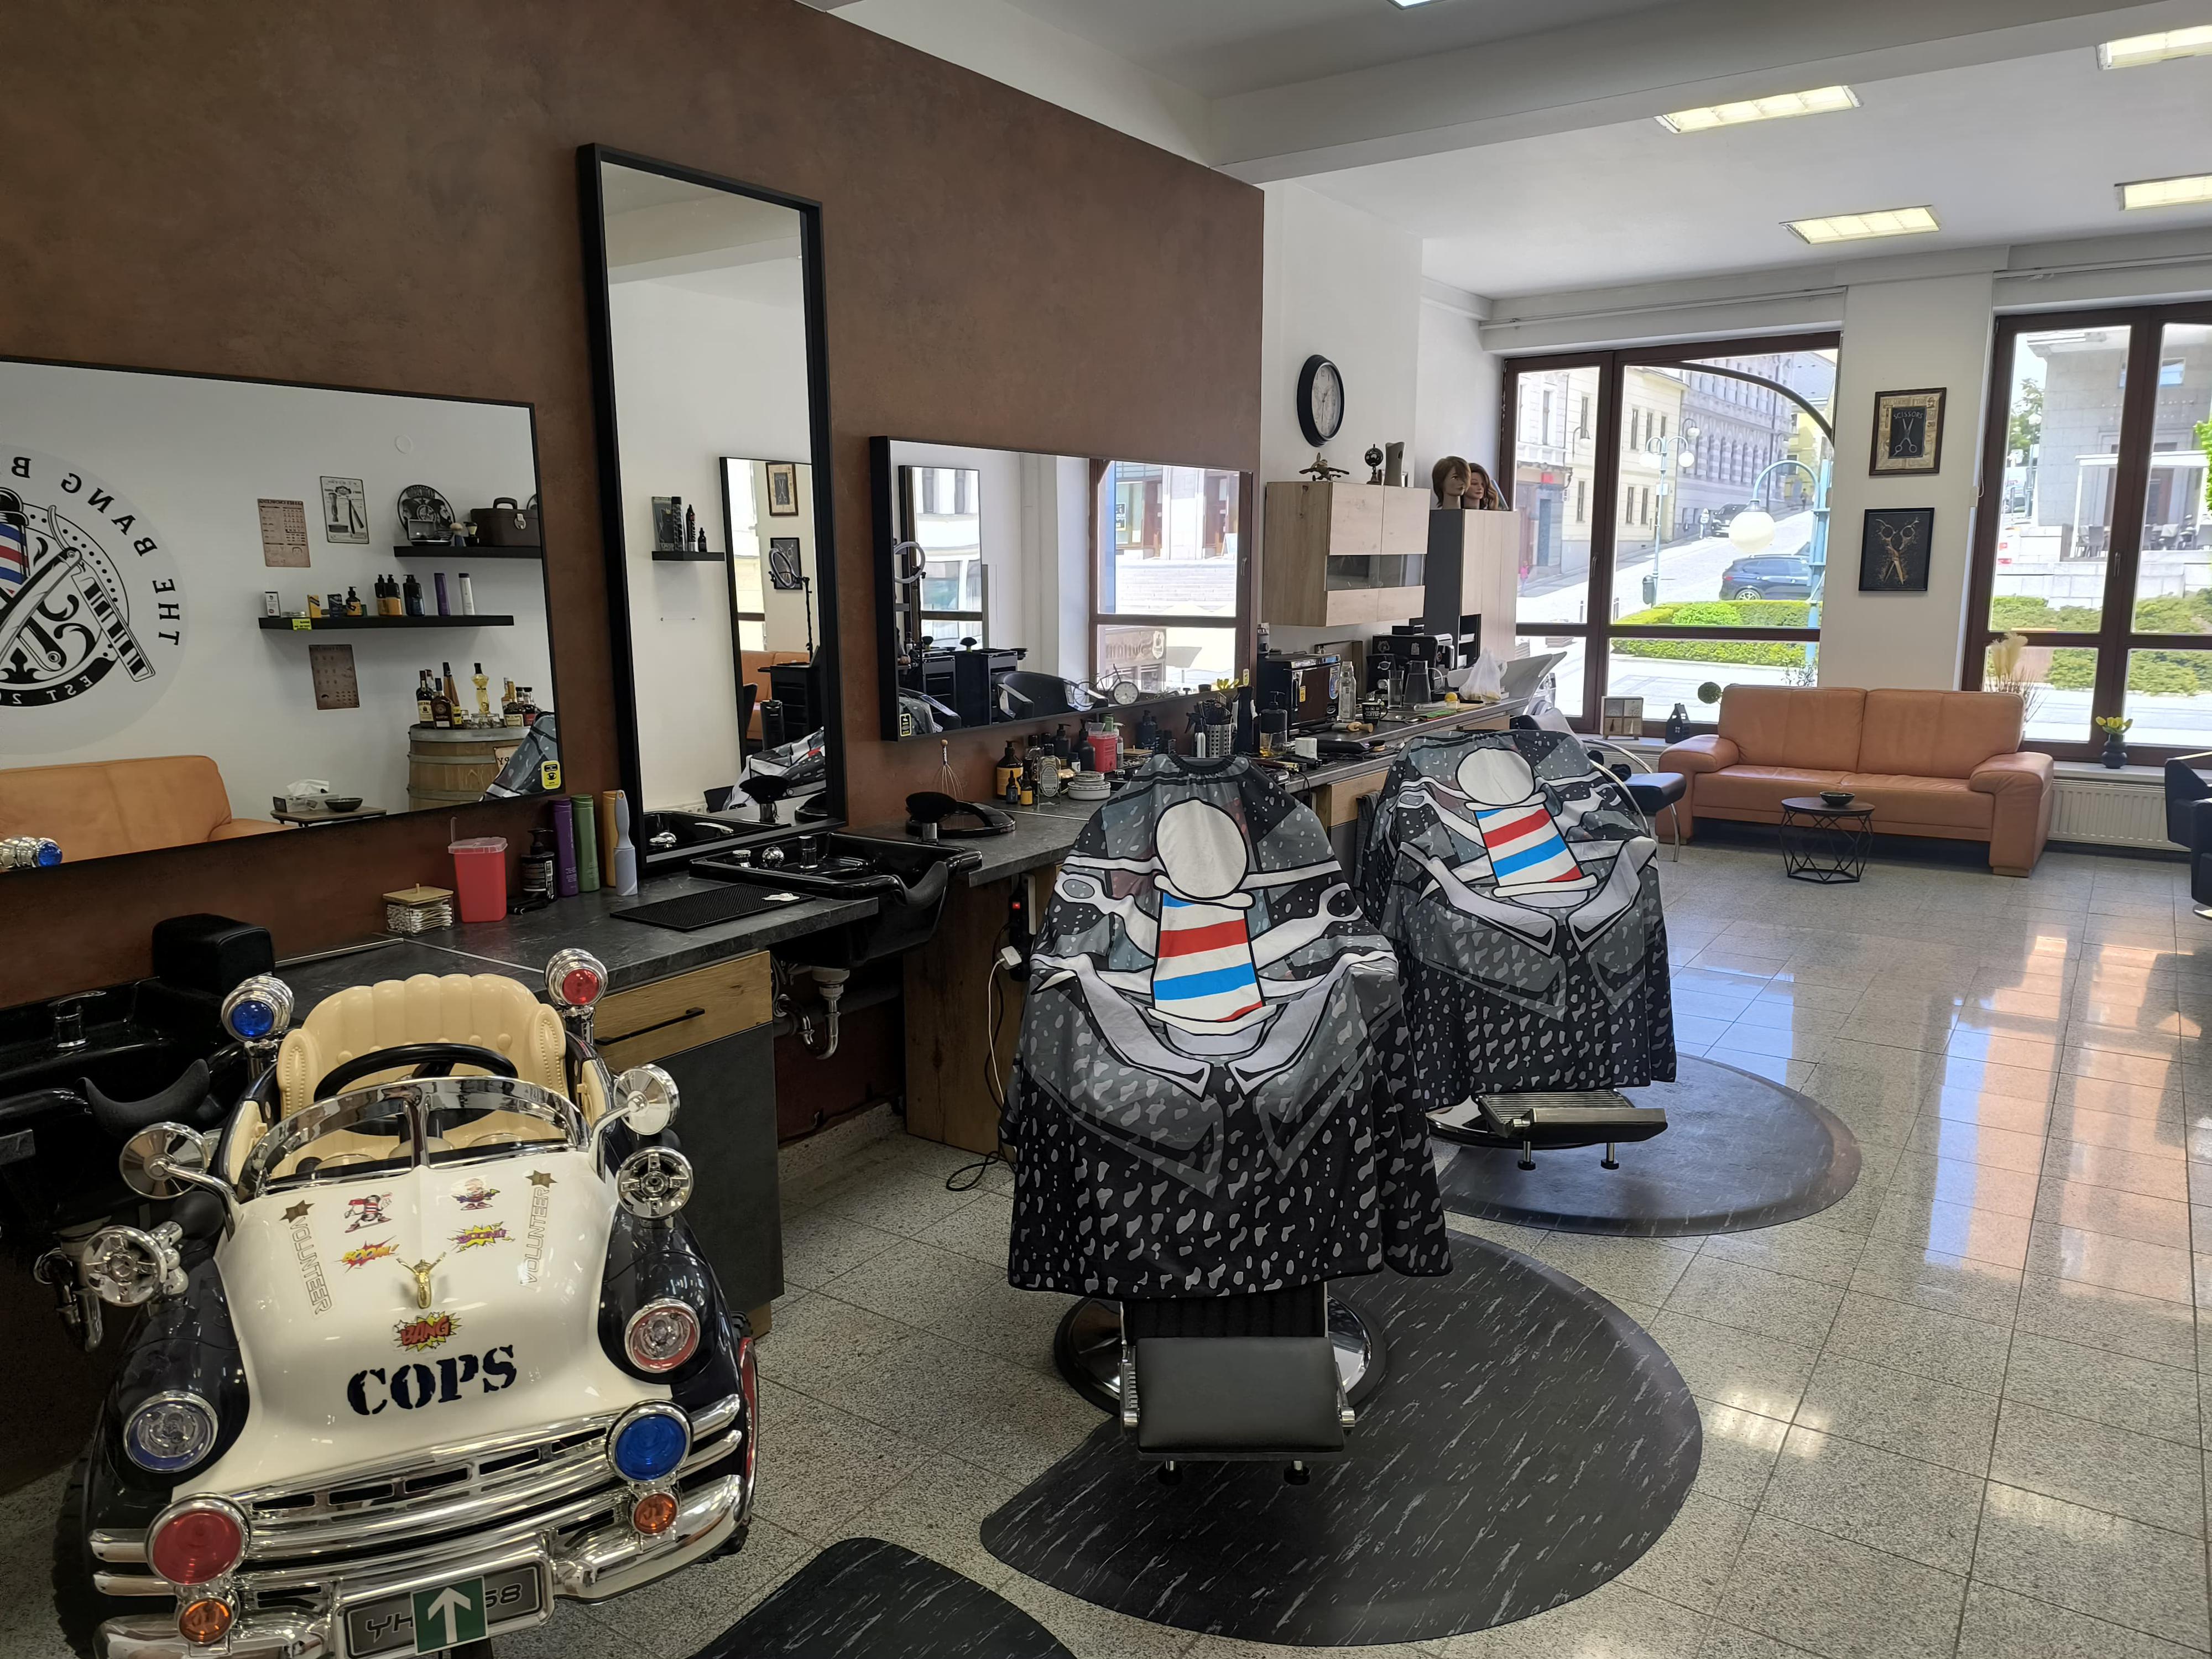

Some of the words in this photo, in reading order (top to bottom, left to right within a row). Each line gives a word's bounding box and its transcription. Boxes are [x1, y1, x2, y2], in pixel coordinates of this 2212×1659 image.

[1893, 411, 1923, 420] SCISSORS
[290, 1217, 333, 1315] VOLUNTEER
[520, 1187, 550, 1284] VOLUNTEER
[400, 1314, 454, 1346] BANG
[347, 1345, 517, 1416] COPS
